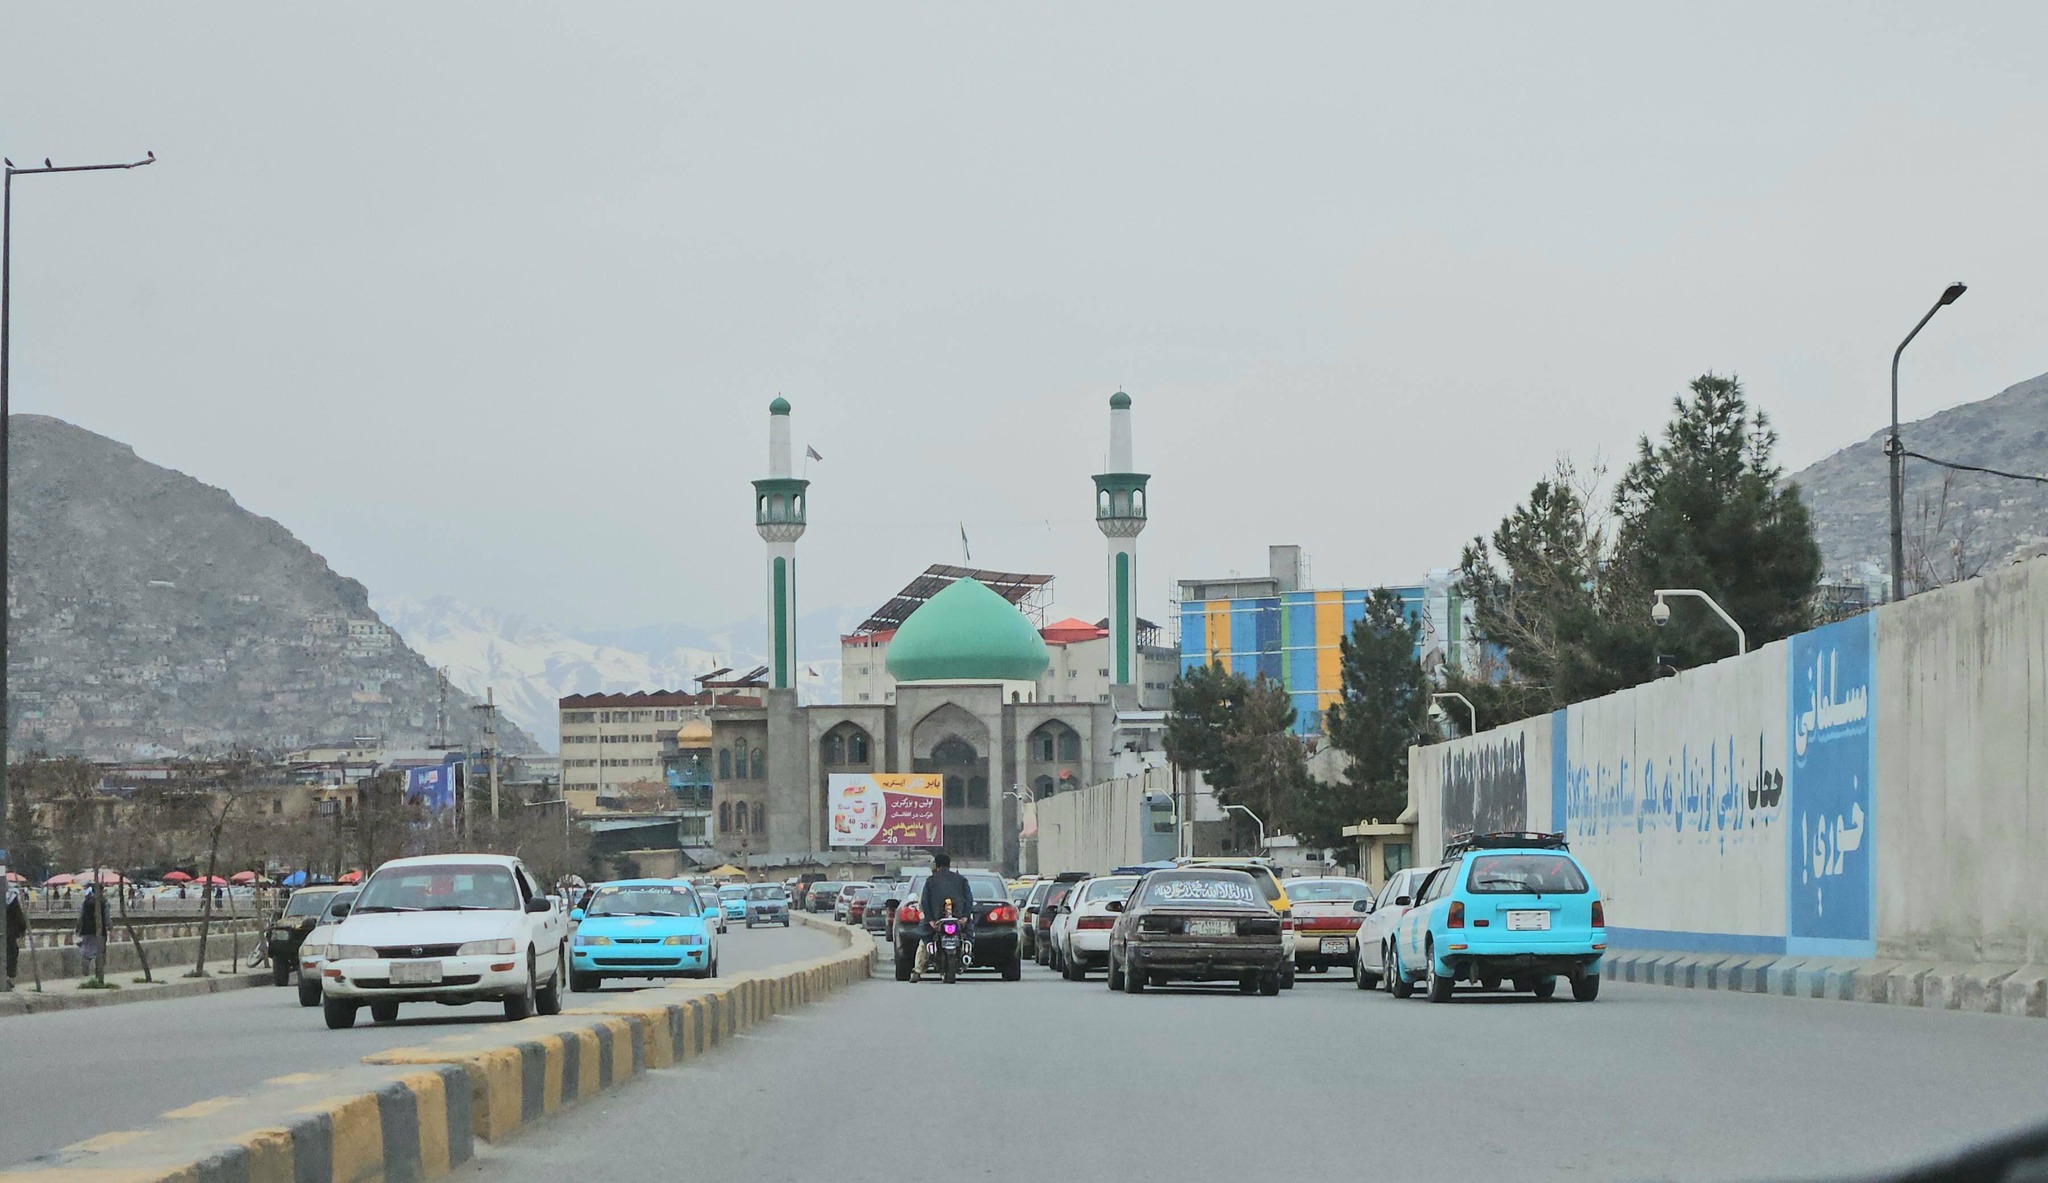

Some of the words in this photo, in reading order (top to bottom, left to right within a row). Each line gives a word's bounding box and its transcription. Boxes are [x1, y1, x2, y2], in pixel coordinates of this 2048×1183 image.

[914, 800, 918, 808] و
[1662, 756, 1672, 816] نه
[1675, 744, 1704, 833] زندان
[1705, 739, 1716, 832] او
[1747, 729, 1783, 828] حجاب
